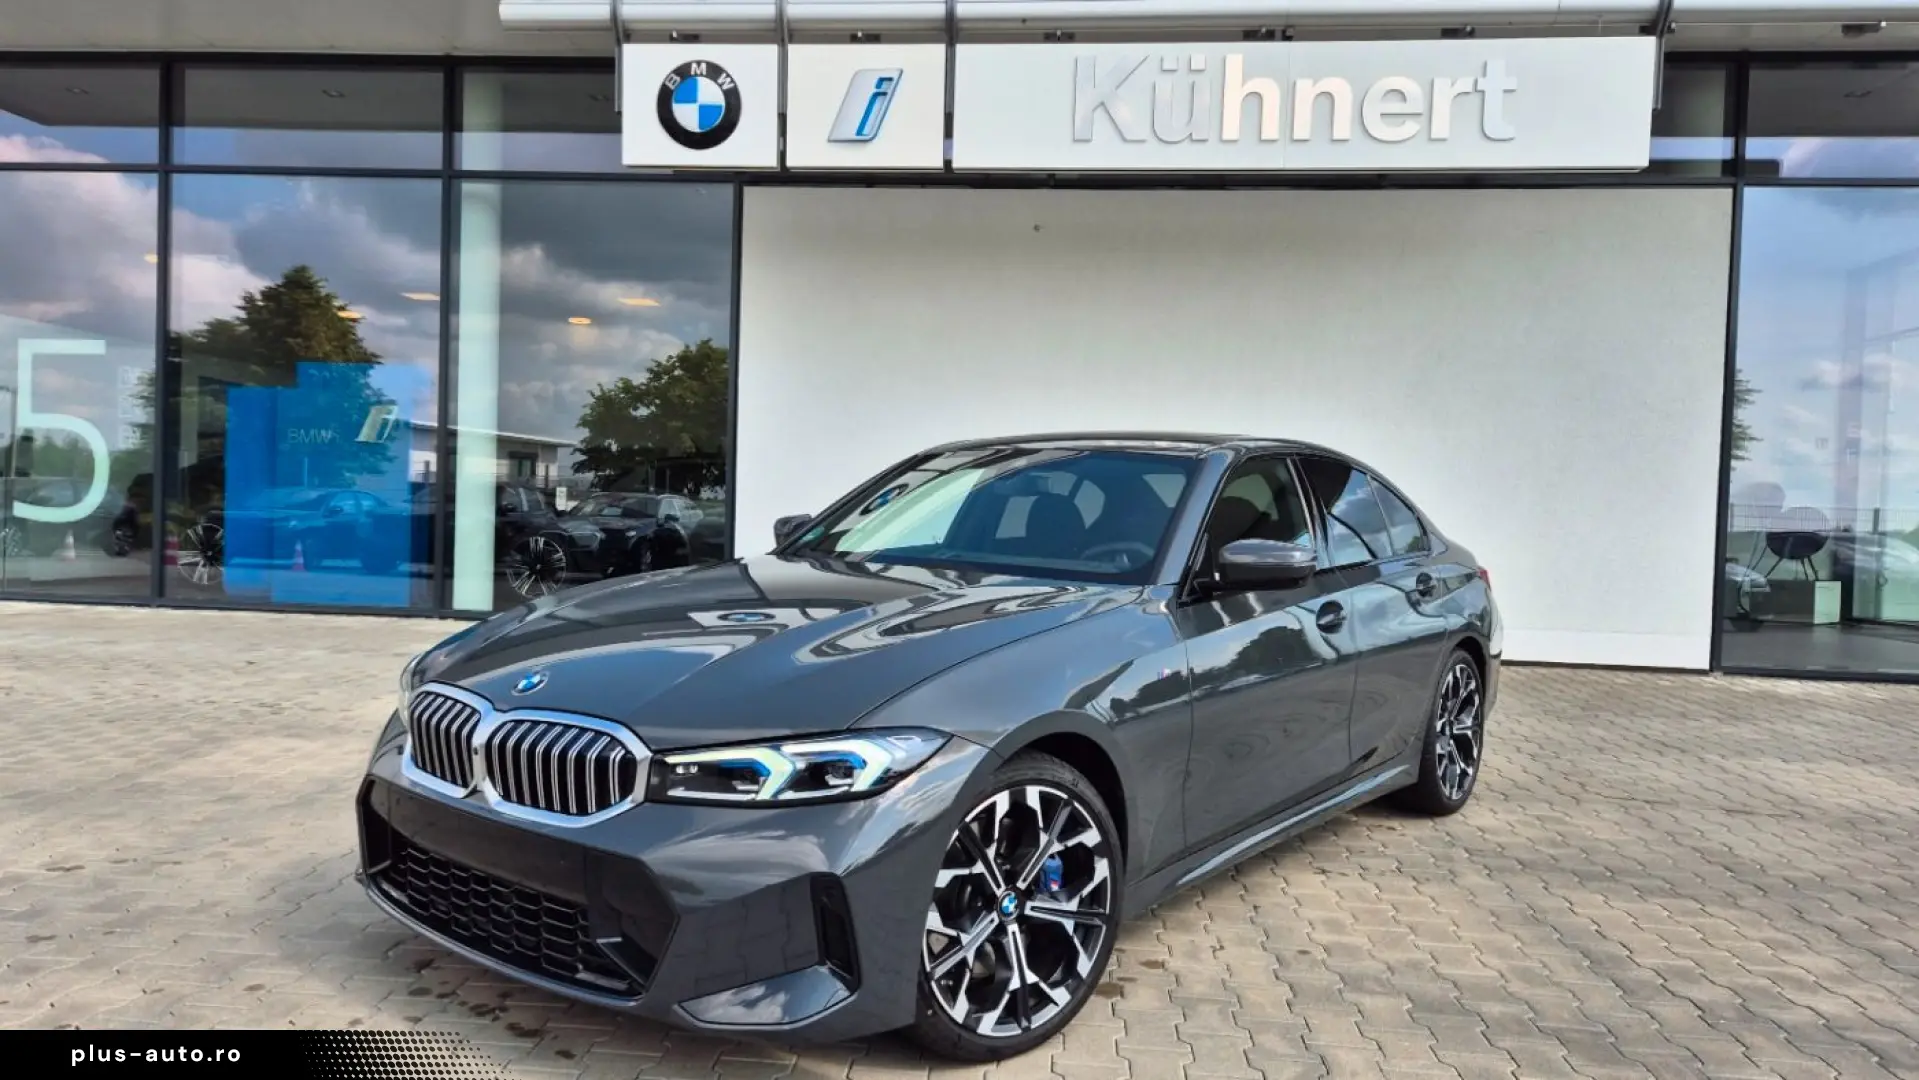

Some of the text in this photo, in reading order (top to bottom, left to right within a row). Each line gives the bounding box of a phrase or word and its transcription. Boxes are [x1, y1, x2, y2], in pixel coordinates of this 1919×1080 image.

[664, 62, 735, 91] BMW
[1072, 53, 1518, 144] Kühnert
[12, 339, 111, 523] 5
